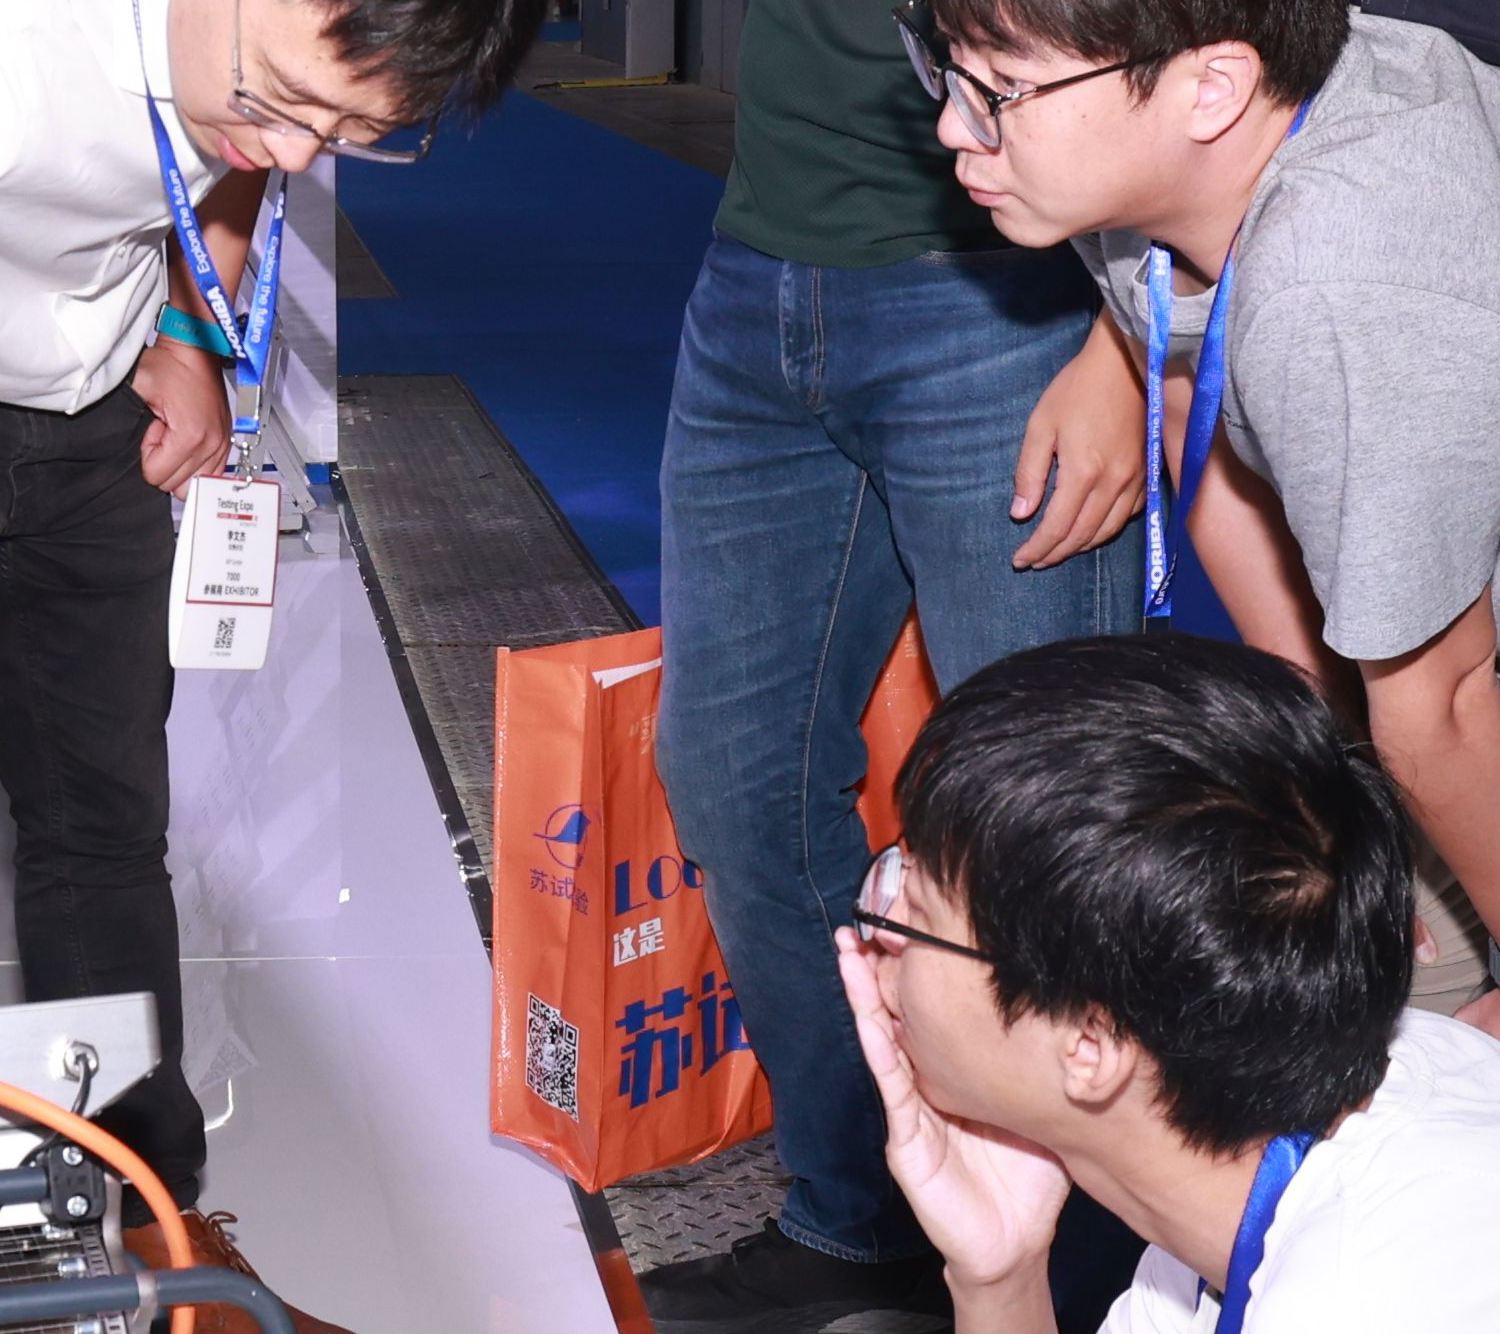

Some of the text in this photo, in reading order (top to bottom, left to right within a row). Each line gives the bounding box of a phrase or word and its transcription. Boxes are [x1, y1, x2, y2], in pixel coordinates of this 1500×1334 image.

[167, 167, 247, 359] HORIBA Explore the future
[262, 234, 280, 283] Explore
[257, 284, 272, 306] the
[250, 306, 268, 344] future
[1151, 416, 1161, 439] the
[1150, 441, 1161, 493] Explore
[217, 497, 254, 513] Testing Expo
[224, 585, 259, 597] EXHIBITOR
[226, 572, 241, 582] 7000
[612, 916, 666, 968] 这是
